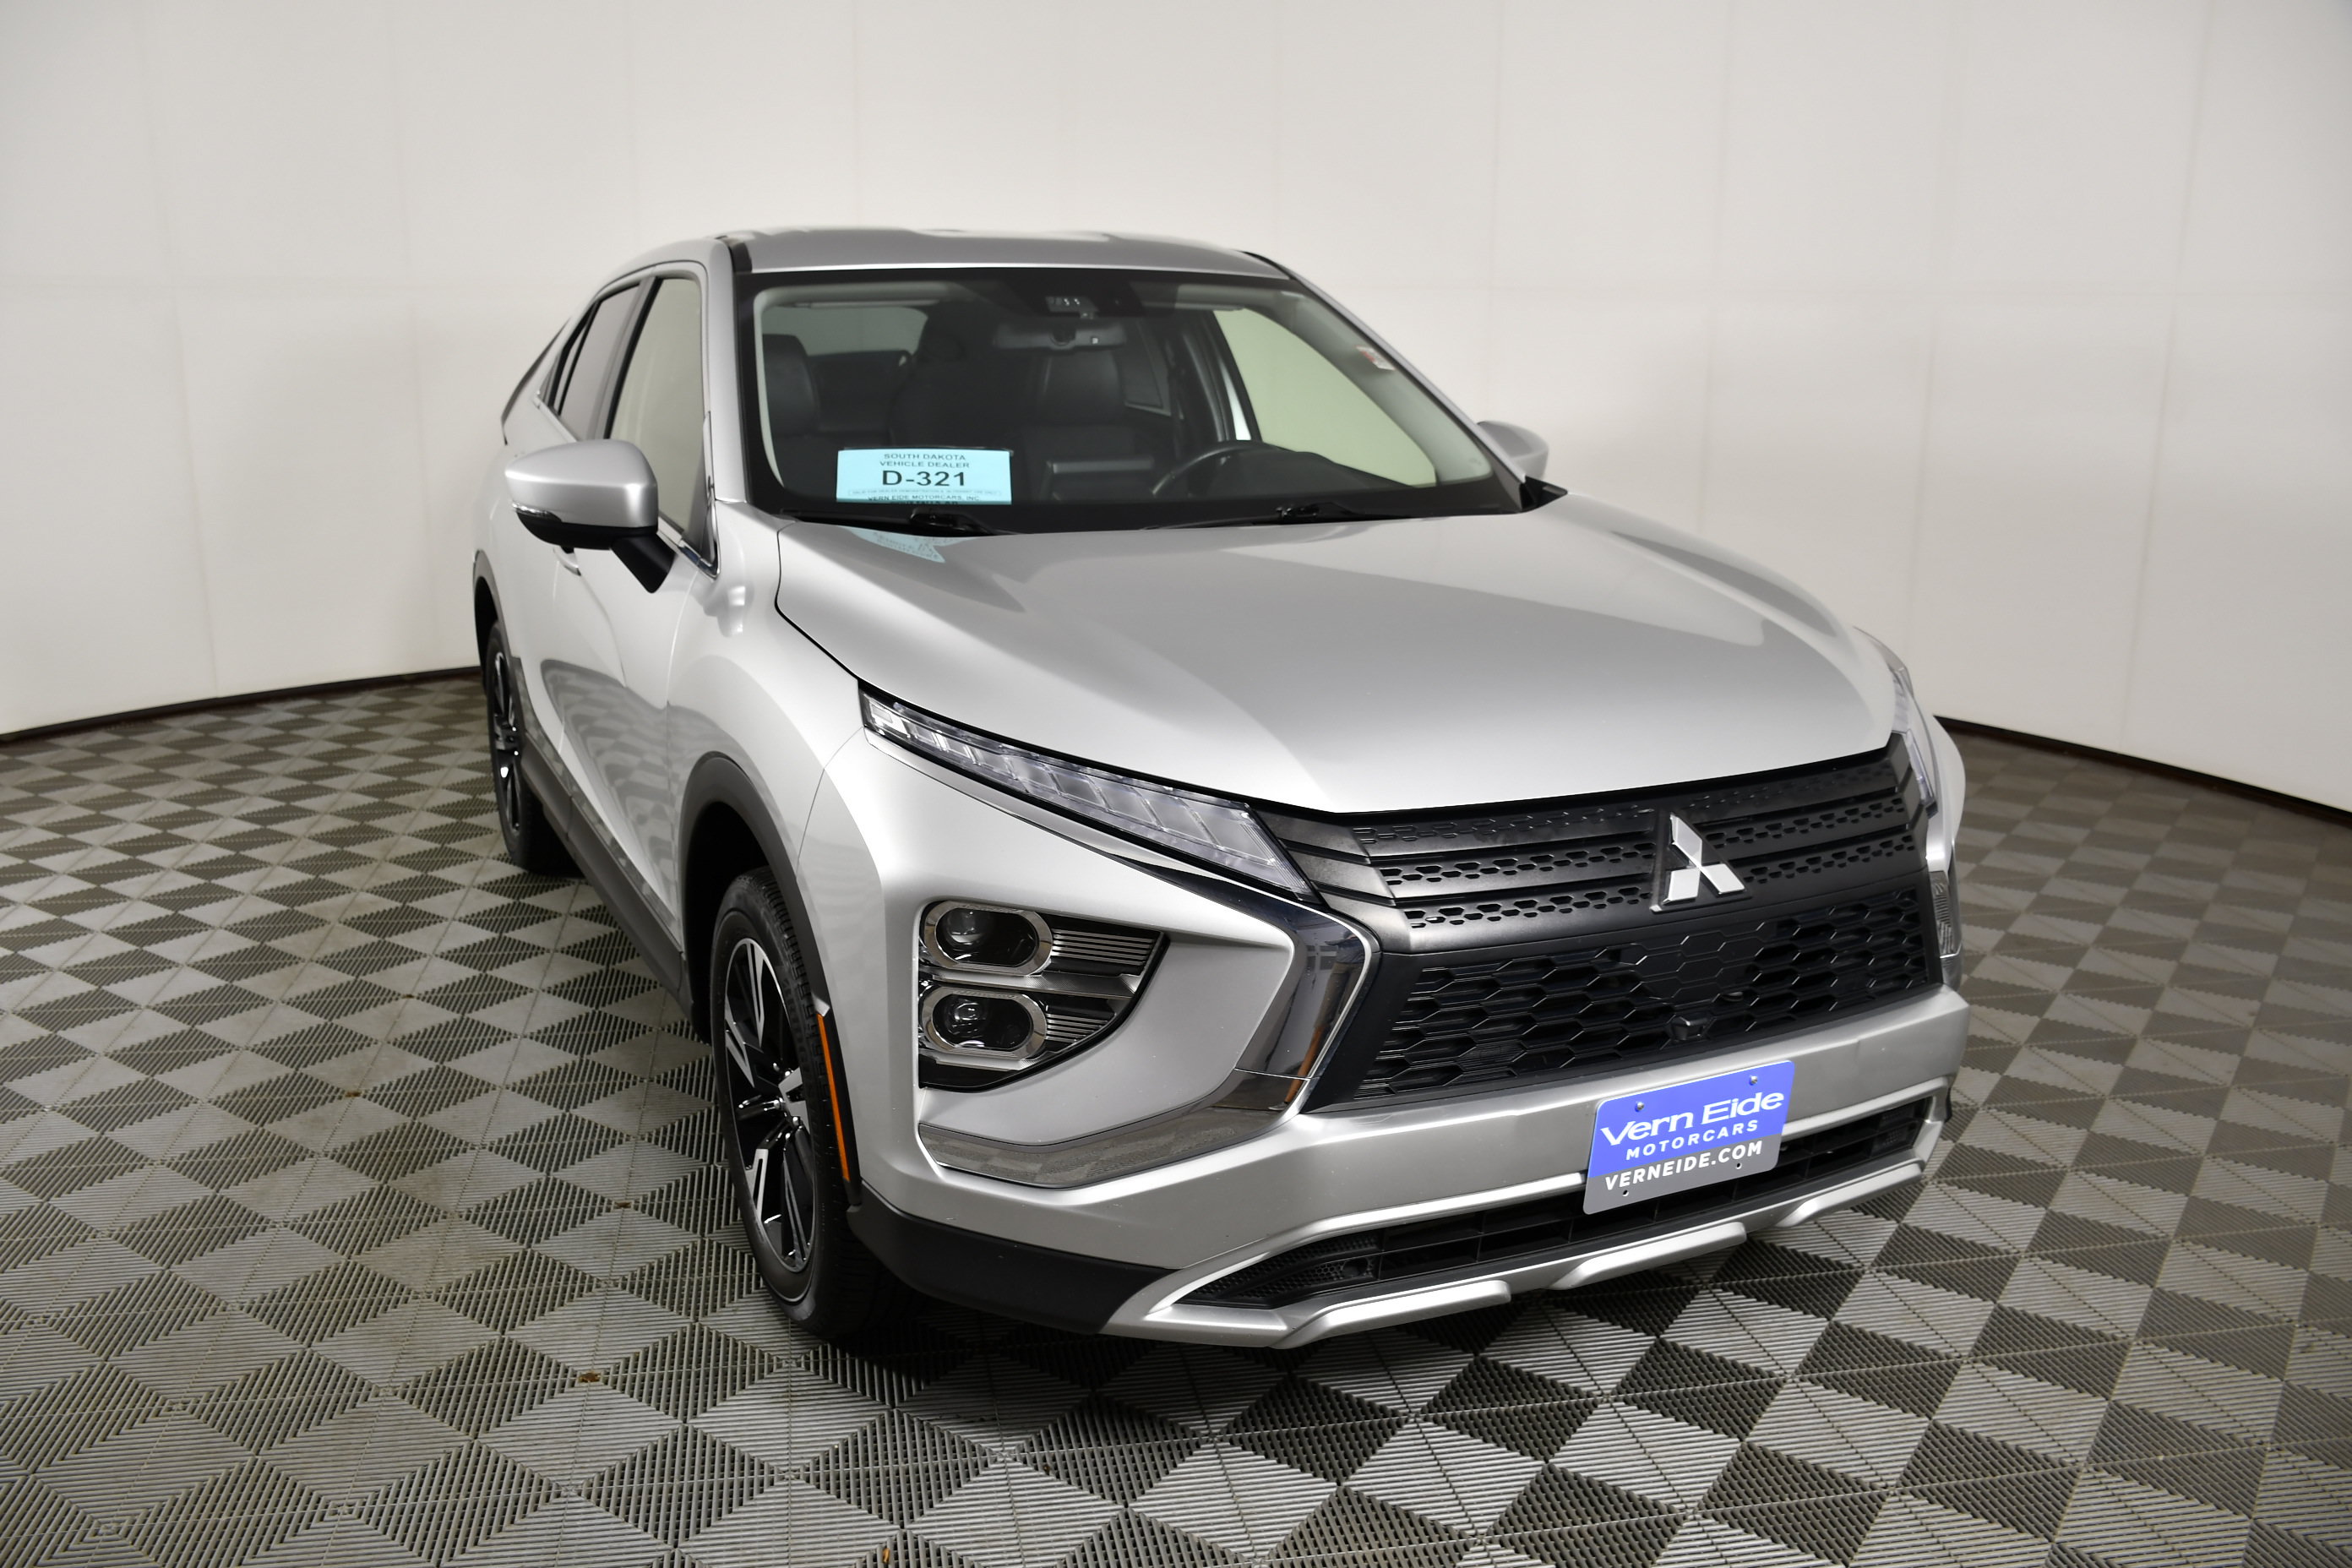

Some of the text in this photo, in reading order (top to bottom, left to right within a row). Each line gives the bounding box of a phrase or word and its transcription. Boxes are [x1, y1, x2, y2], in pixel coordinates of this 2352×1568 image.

[882, 470, 965, 487] D-321
[1600, 1092, 1784, 1146] Vern Eide
[1625, 1119, 1758, 1161] MOTORCARS
[1605, 1141, 1762, 1190] VERNEIDE.COM
